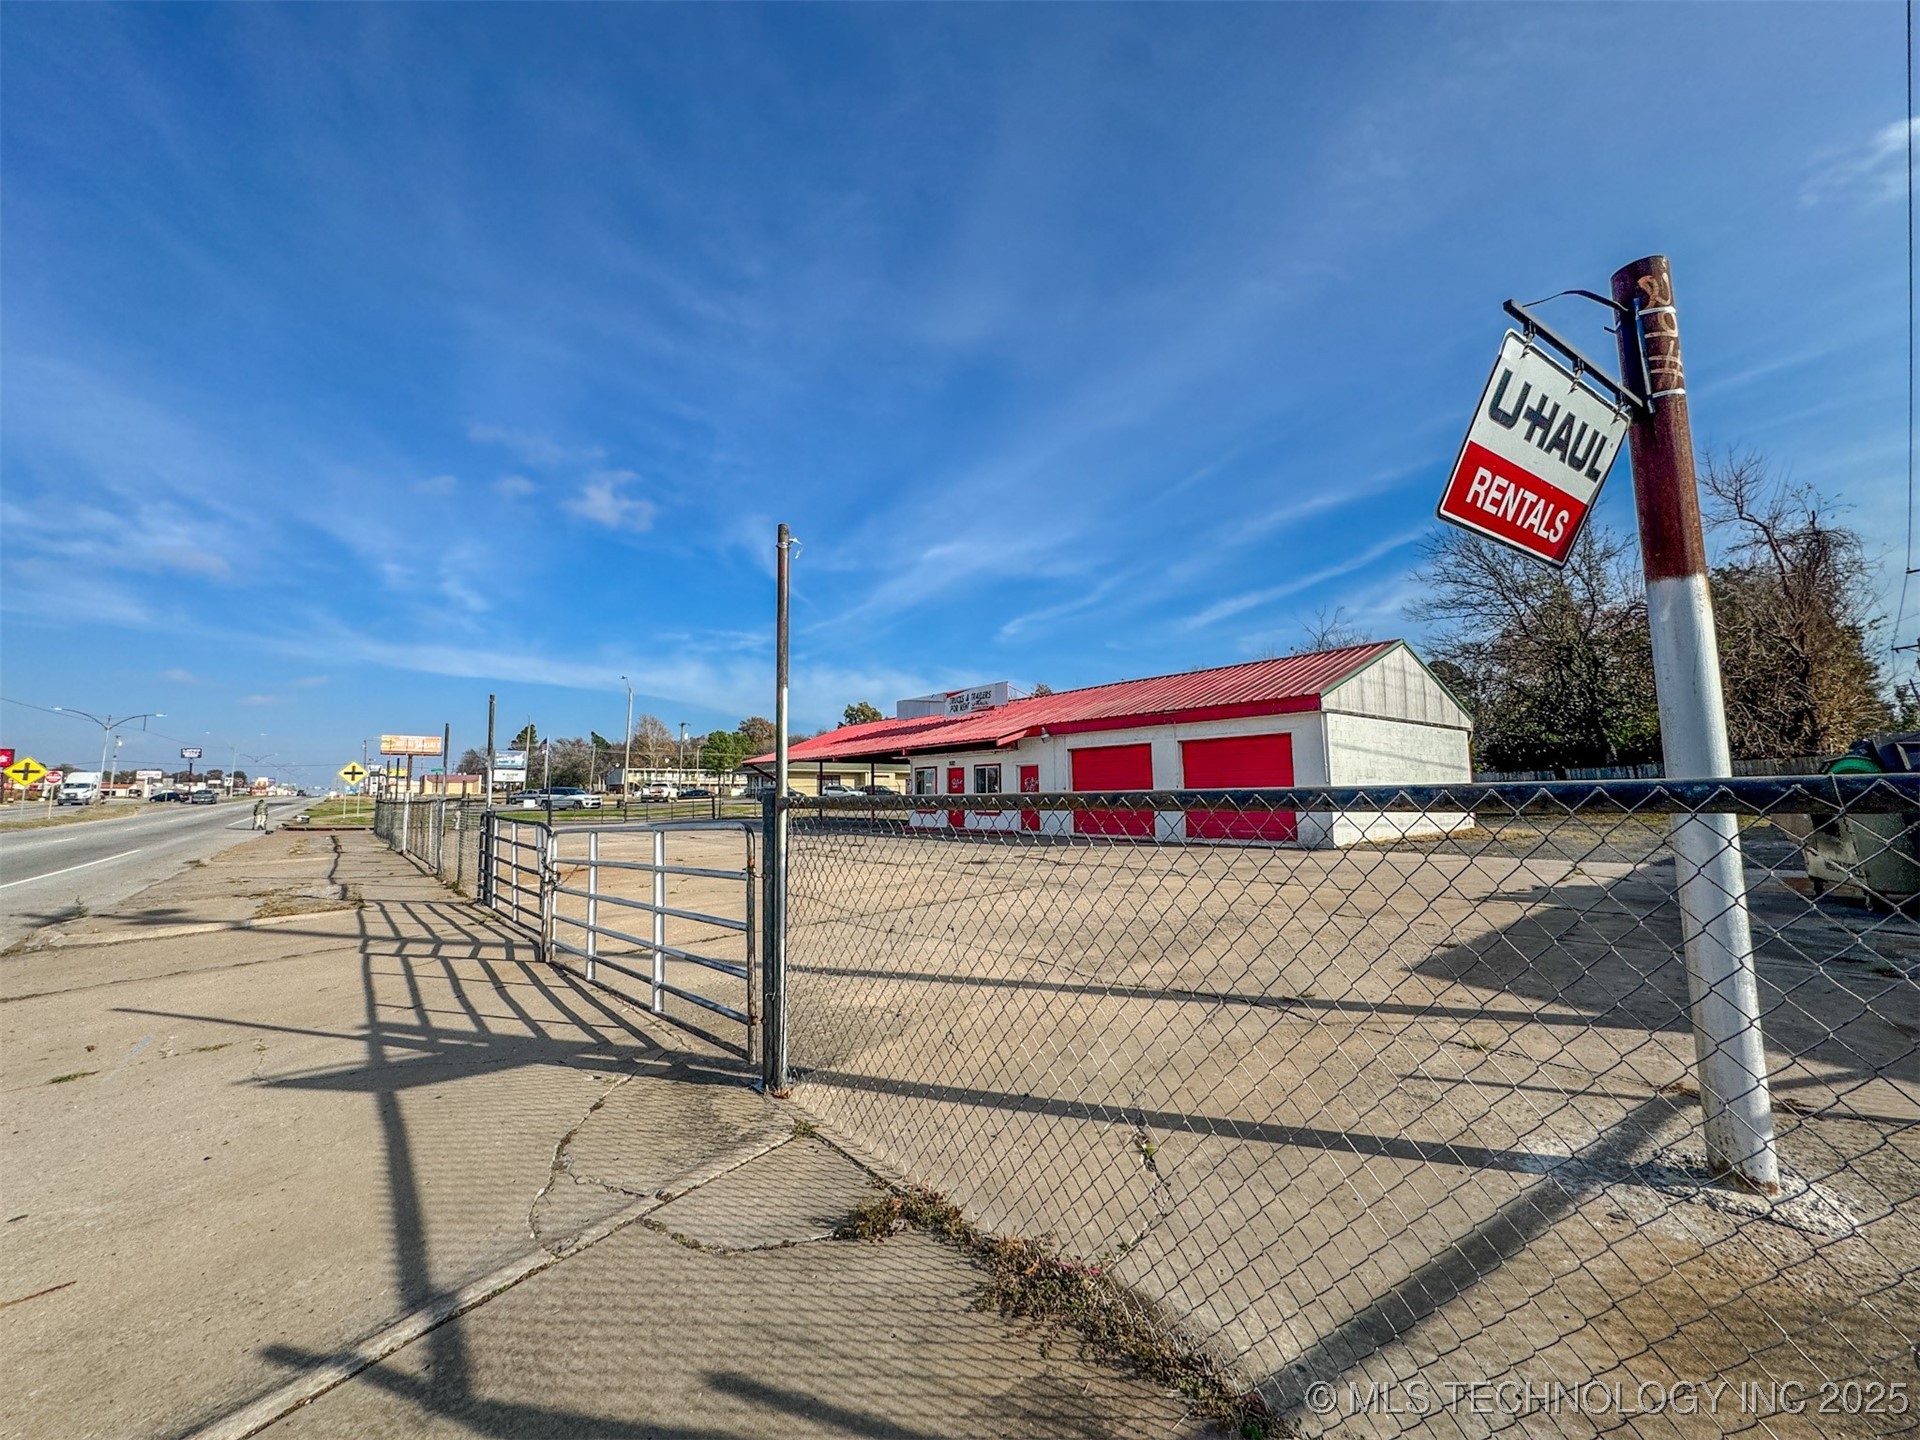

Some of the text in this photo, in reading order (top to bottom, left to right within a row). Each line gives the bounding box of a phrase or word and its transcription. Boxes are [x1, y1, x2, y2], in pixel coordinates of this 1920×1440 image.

[1488, 367, 1608, 483] U-HAUL
[1465, 466, 1570, 544] RENTALS
[949, 701, 970, 713] FOR RENT
